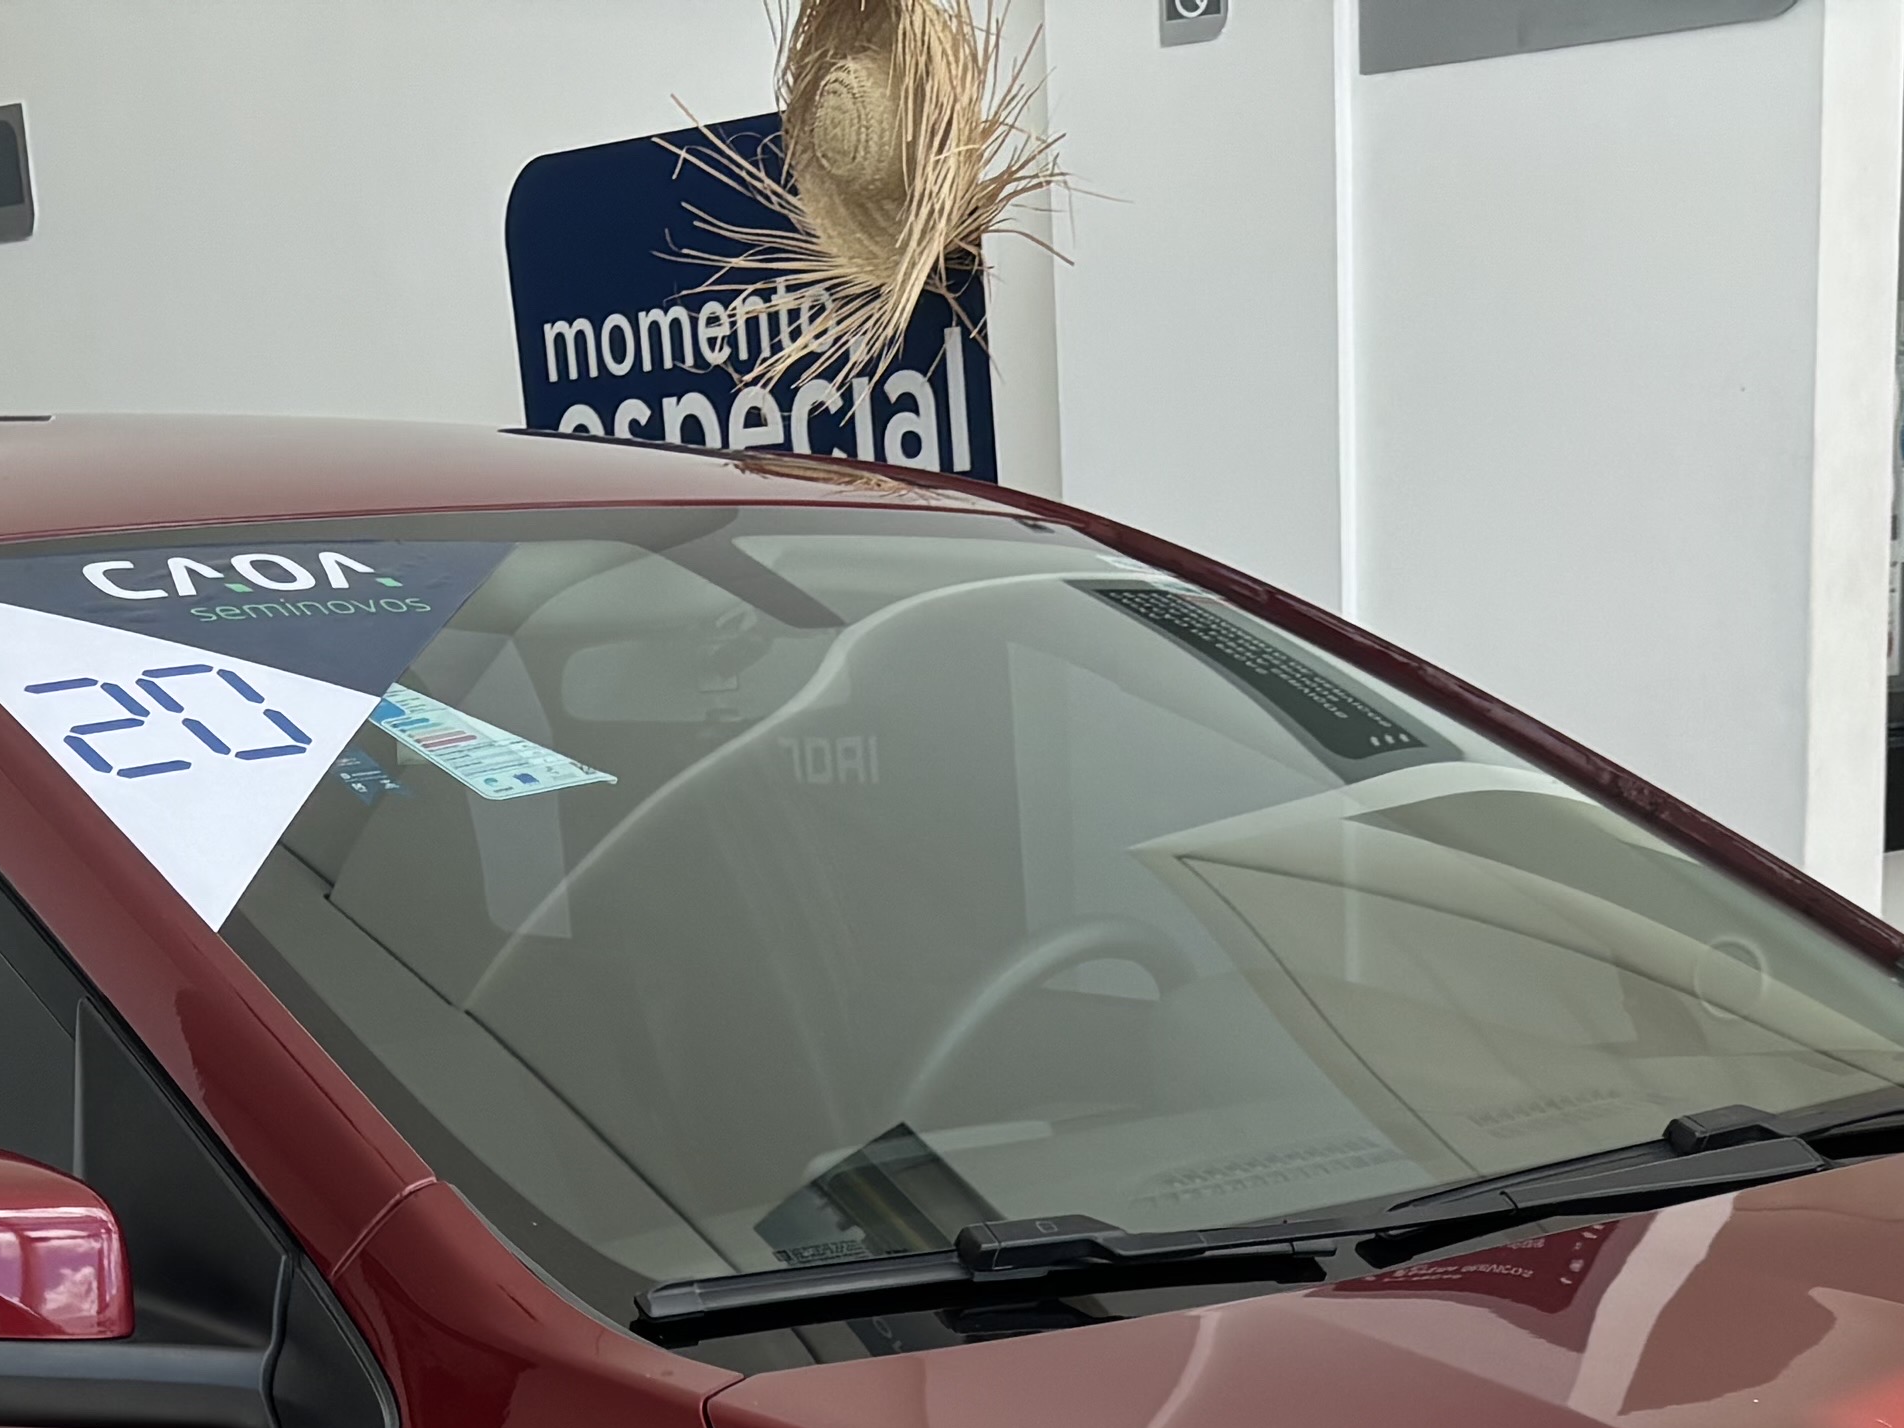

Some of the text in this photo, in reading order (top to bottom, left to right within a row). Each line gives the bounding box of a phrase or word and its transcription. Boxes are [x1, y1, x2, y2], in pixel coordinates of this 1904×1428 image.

[81, 549, 402, 602] CAOA
[189, 592, 434, 624] seminovos
[23, 663, 314, 779] 20
